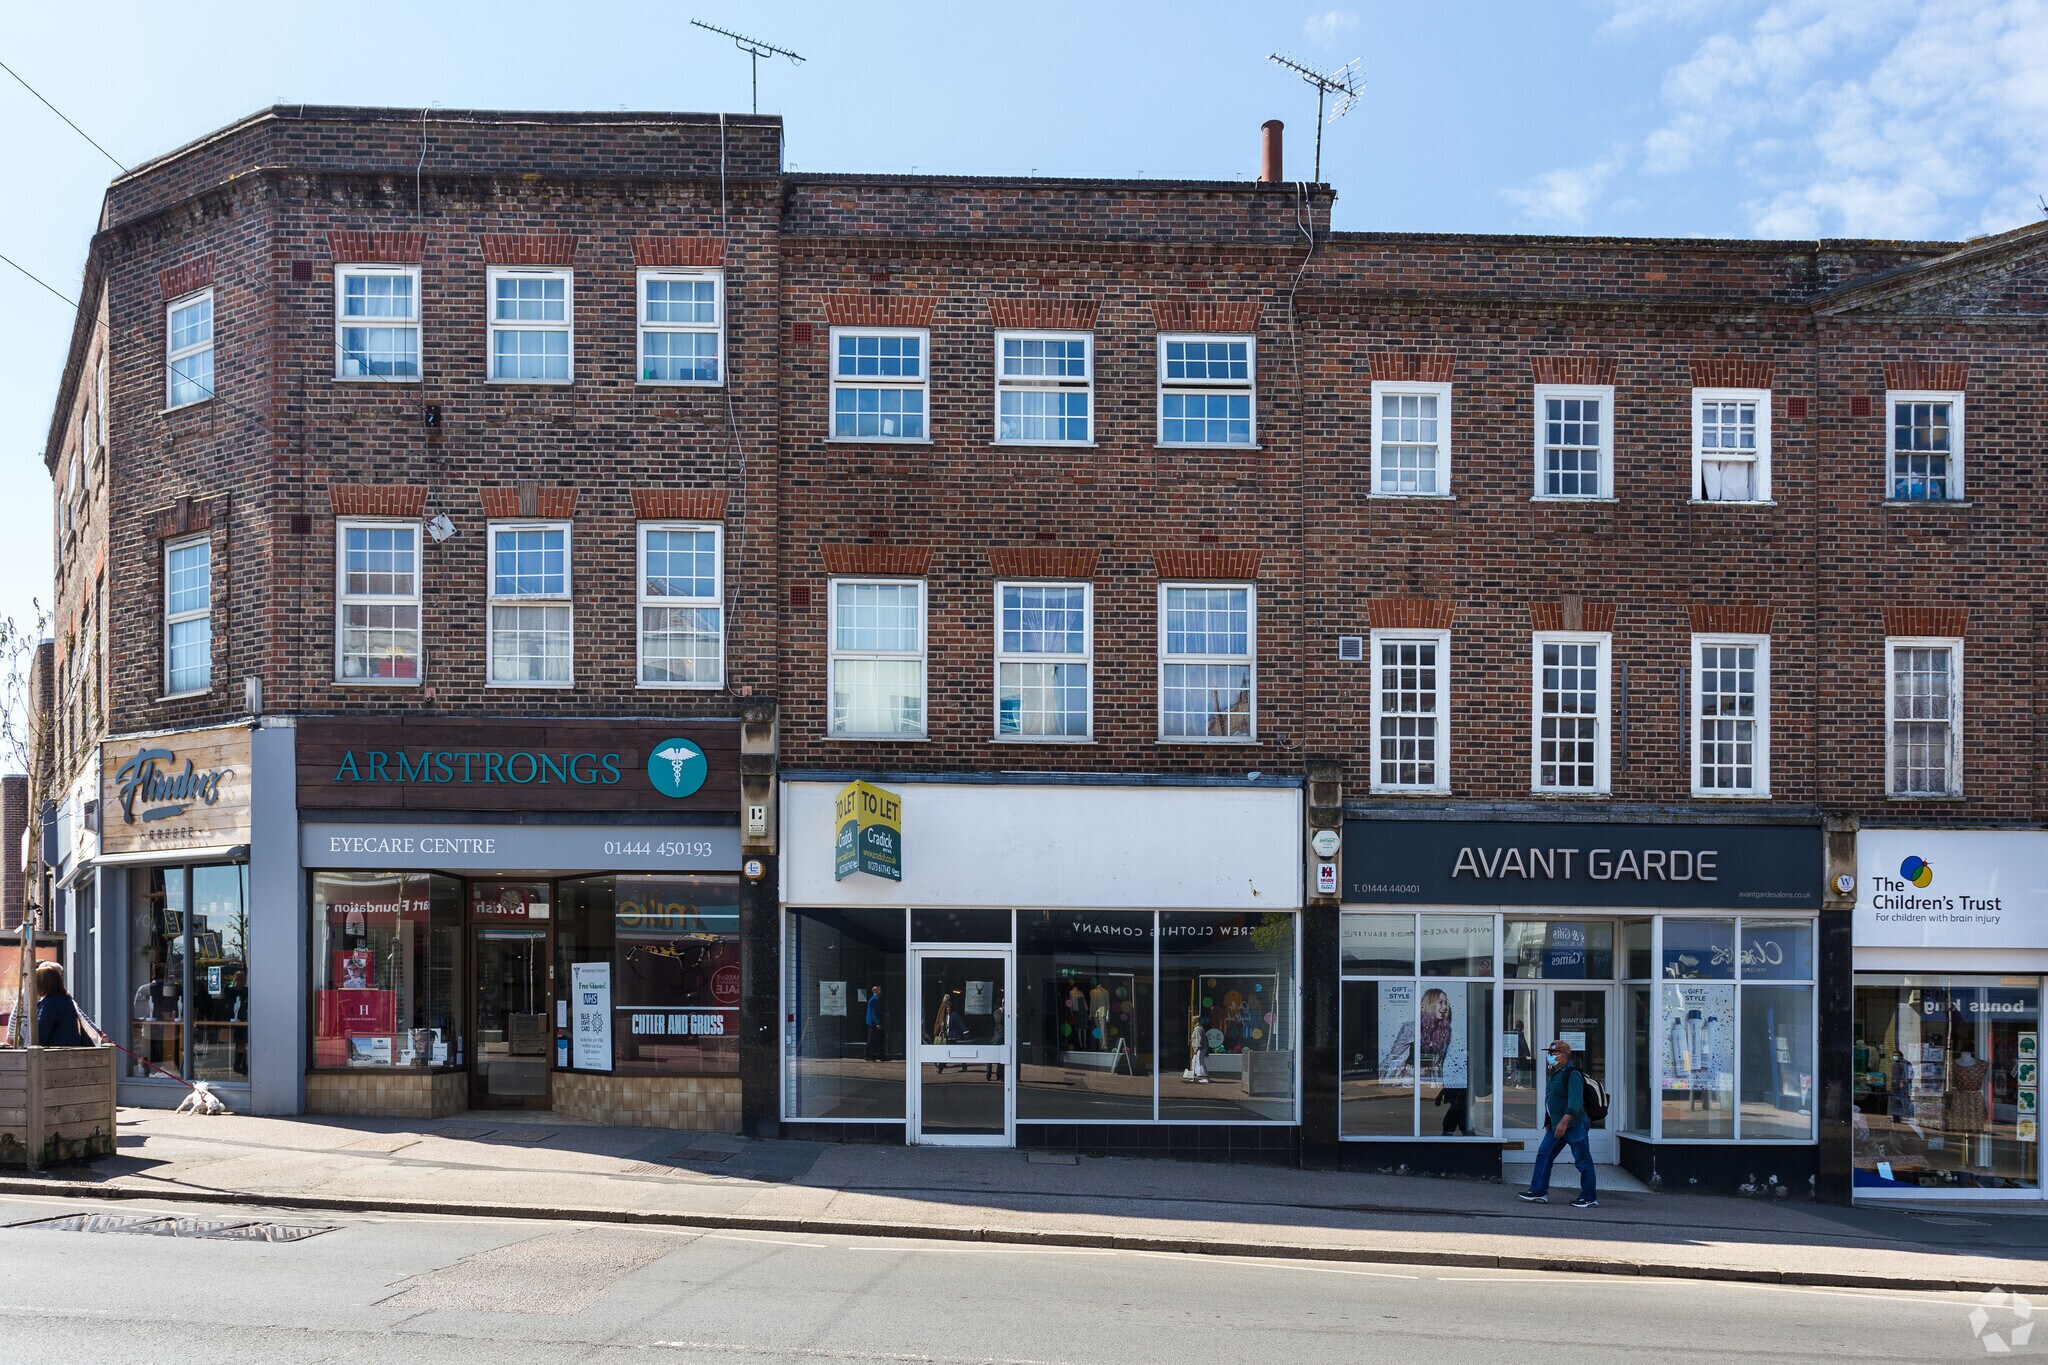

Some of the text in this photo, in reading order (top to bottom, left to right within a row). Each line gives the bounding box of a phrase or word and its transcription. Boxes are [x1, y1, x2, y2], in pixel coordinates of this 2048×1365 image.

[332, 750, 621, 784] ARMSTRONGS
[115, 748, 235, 824] Flinders
[844, 791, 856, 815] LET
[862, 791, 898, 821] TO LET
[330, 837, 495, 854] EYECARE CENTRE
[868, 827, 893, 849] Cradick
[604, 841, 712, 857] 01444 450193
[1451, 847, 1718, 881] AVANT GARDE
[1353, 884, 1420, 893] T. 01444 440401
[1873, 877, 1905, 892] The
[1738, 890, 1811, 899] avantgardesalons.co.uk
[1873, 894, 2001, 911] Children's Trust
[1876, 913, 2000, 924] For children with brain injury
[632, 1014, 724, 1035] CUTLER AND GROSS
